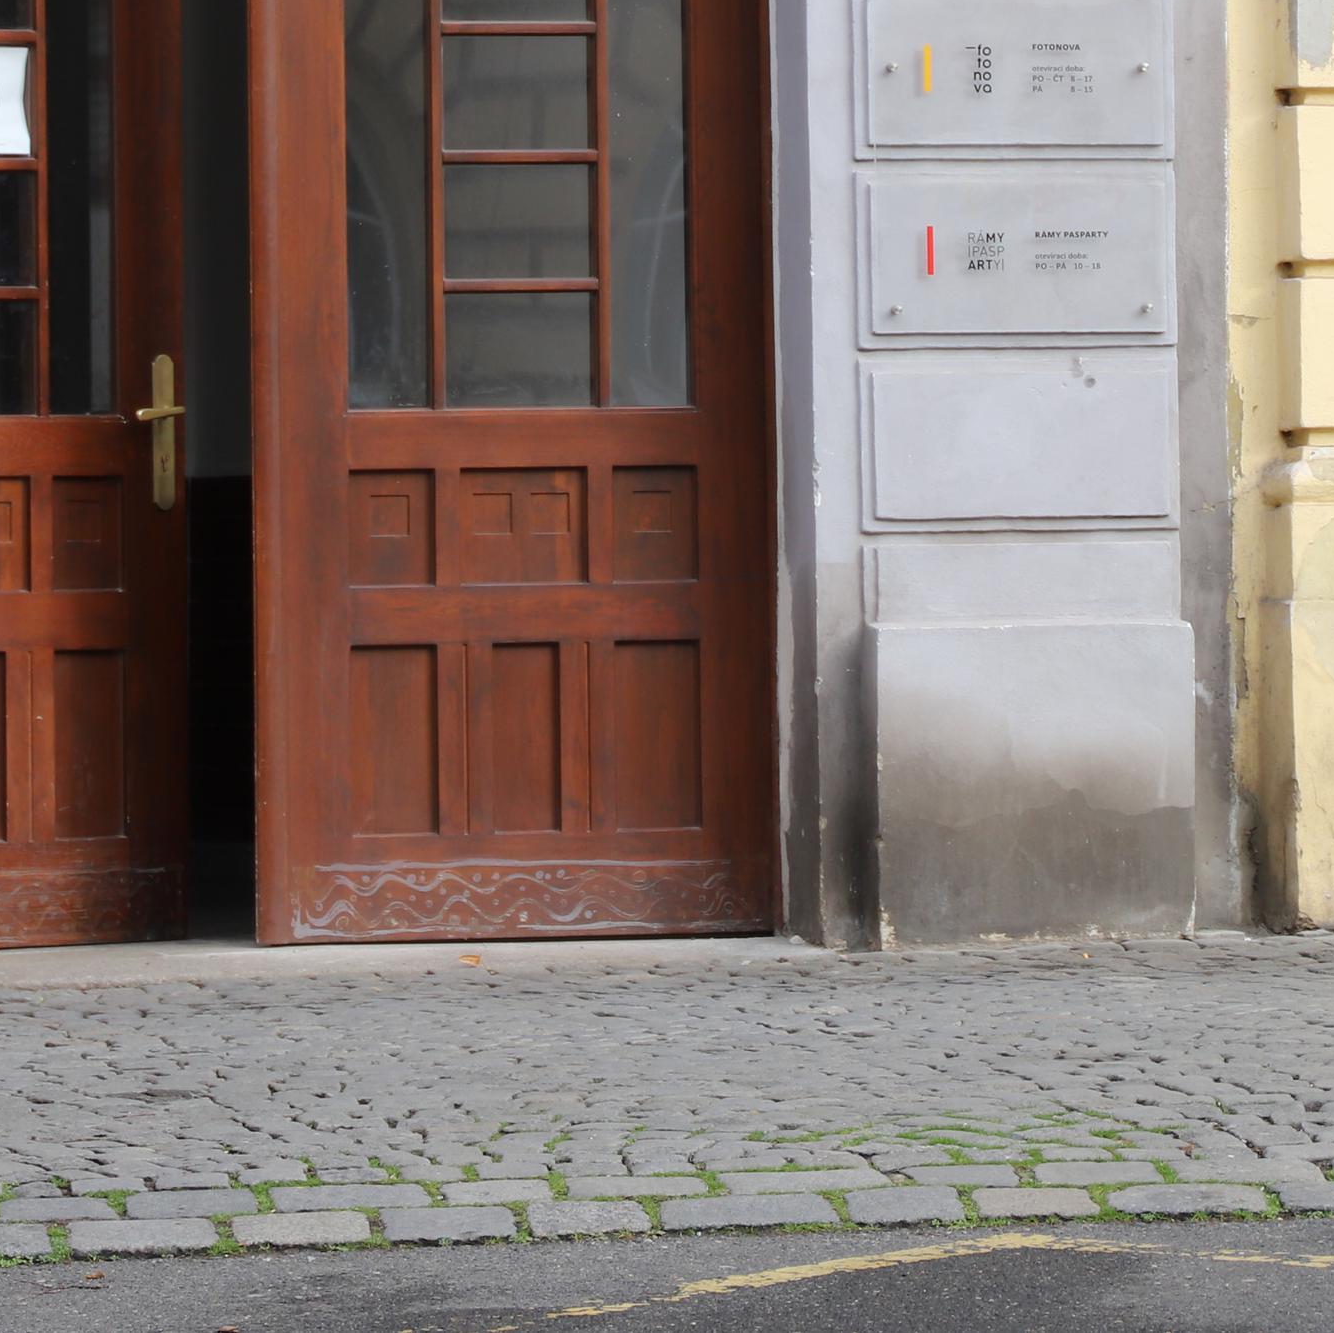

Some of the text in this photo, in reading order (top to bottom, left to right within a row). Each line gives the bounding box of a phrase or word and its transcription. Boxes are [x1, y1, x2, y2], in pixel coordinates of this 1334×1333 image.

[1032, 43, 1081, 51] FOTONOVA
[973, 70, 993, 82] no
[973, 83, 993, 94] va
[967, 229, 1005, 244] RÁMY
[1035, 231, 1109, 239] RÁMY PASPARTY
